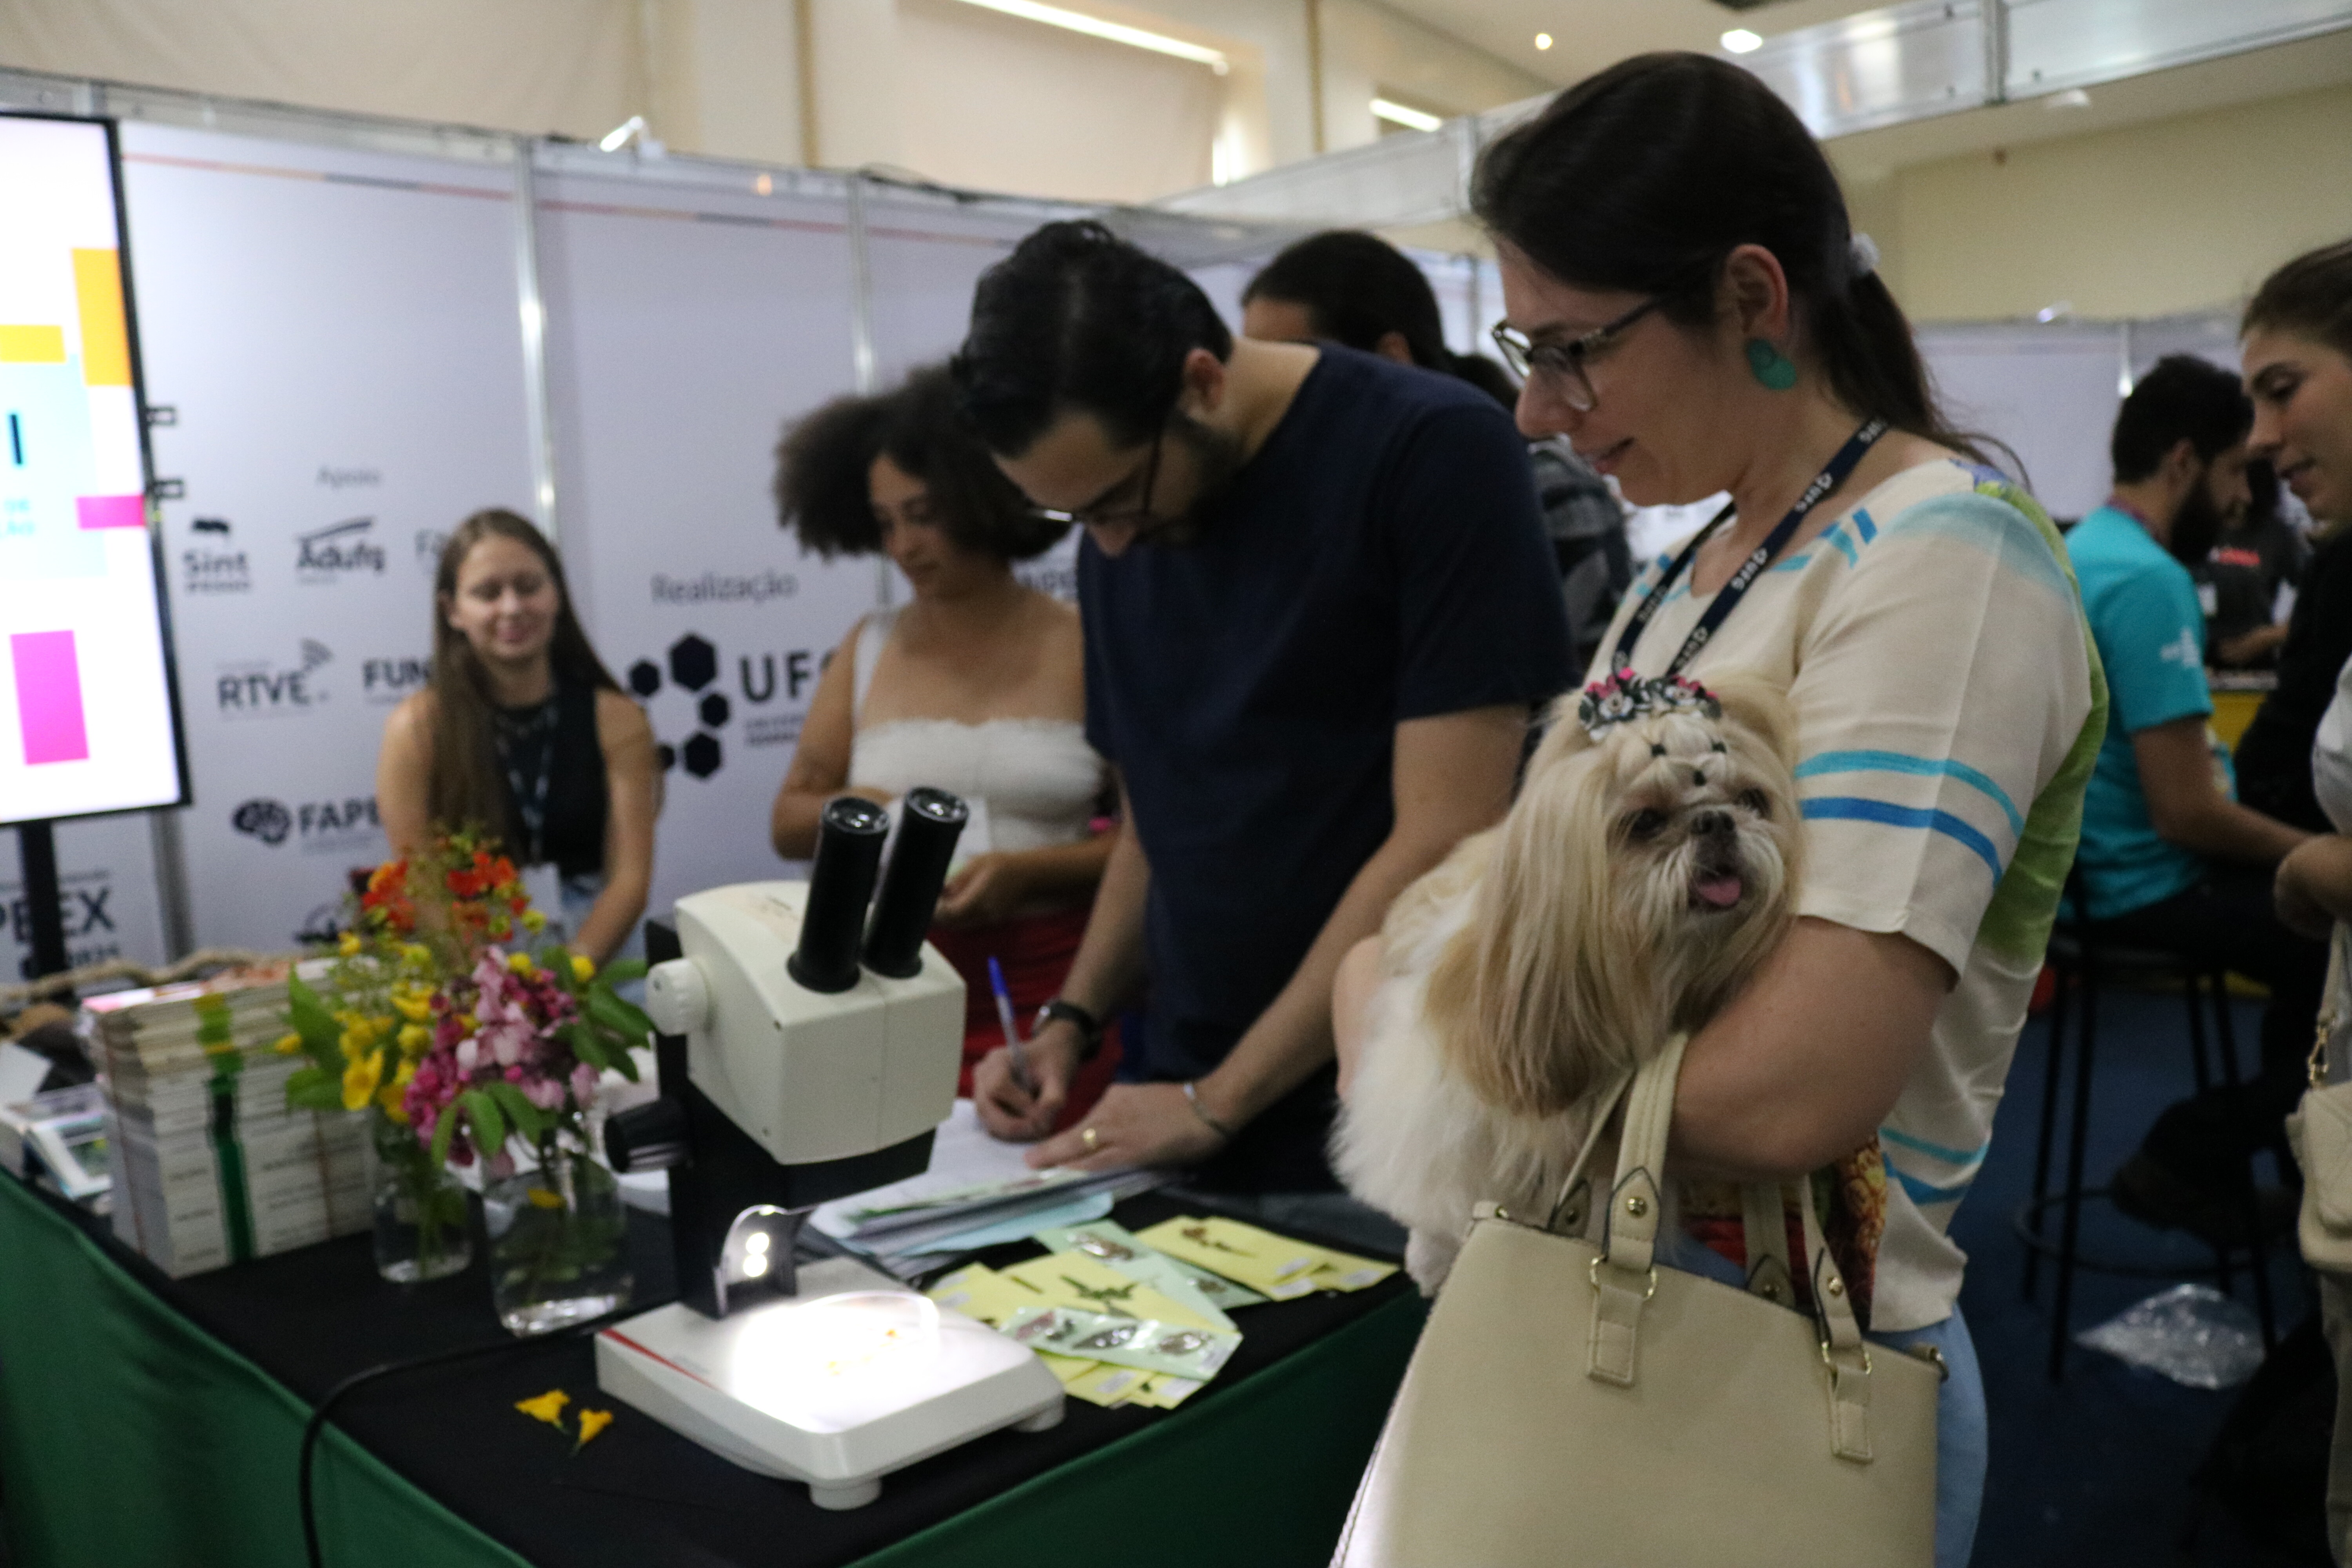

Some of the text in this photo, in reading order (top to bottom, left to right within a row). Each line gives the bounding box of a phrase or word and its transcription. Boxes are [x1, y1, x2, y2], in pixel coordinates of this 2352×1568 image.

[651, 570, 799, 606] Realização
[218, 671, 310, 708] RTVE
[740, 649, 836, 703] UF
